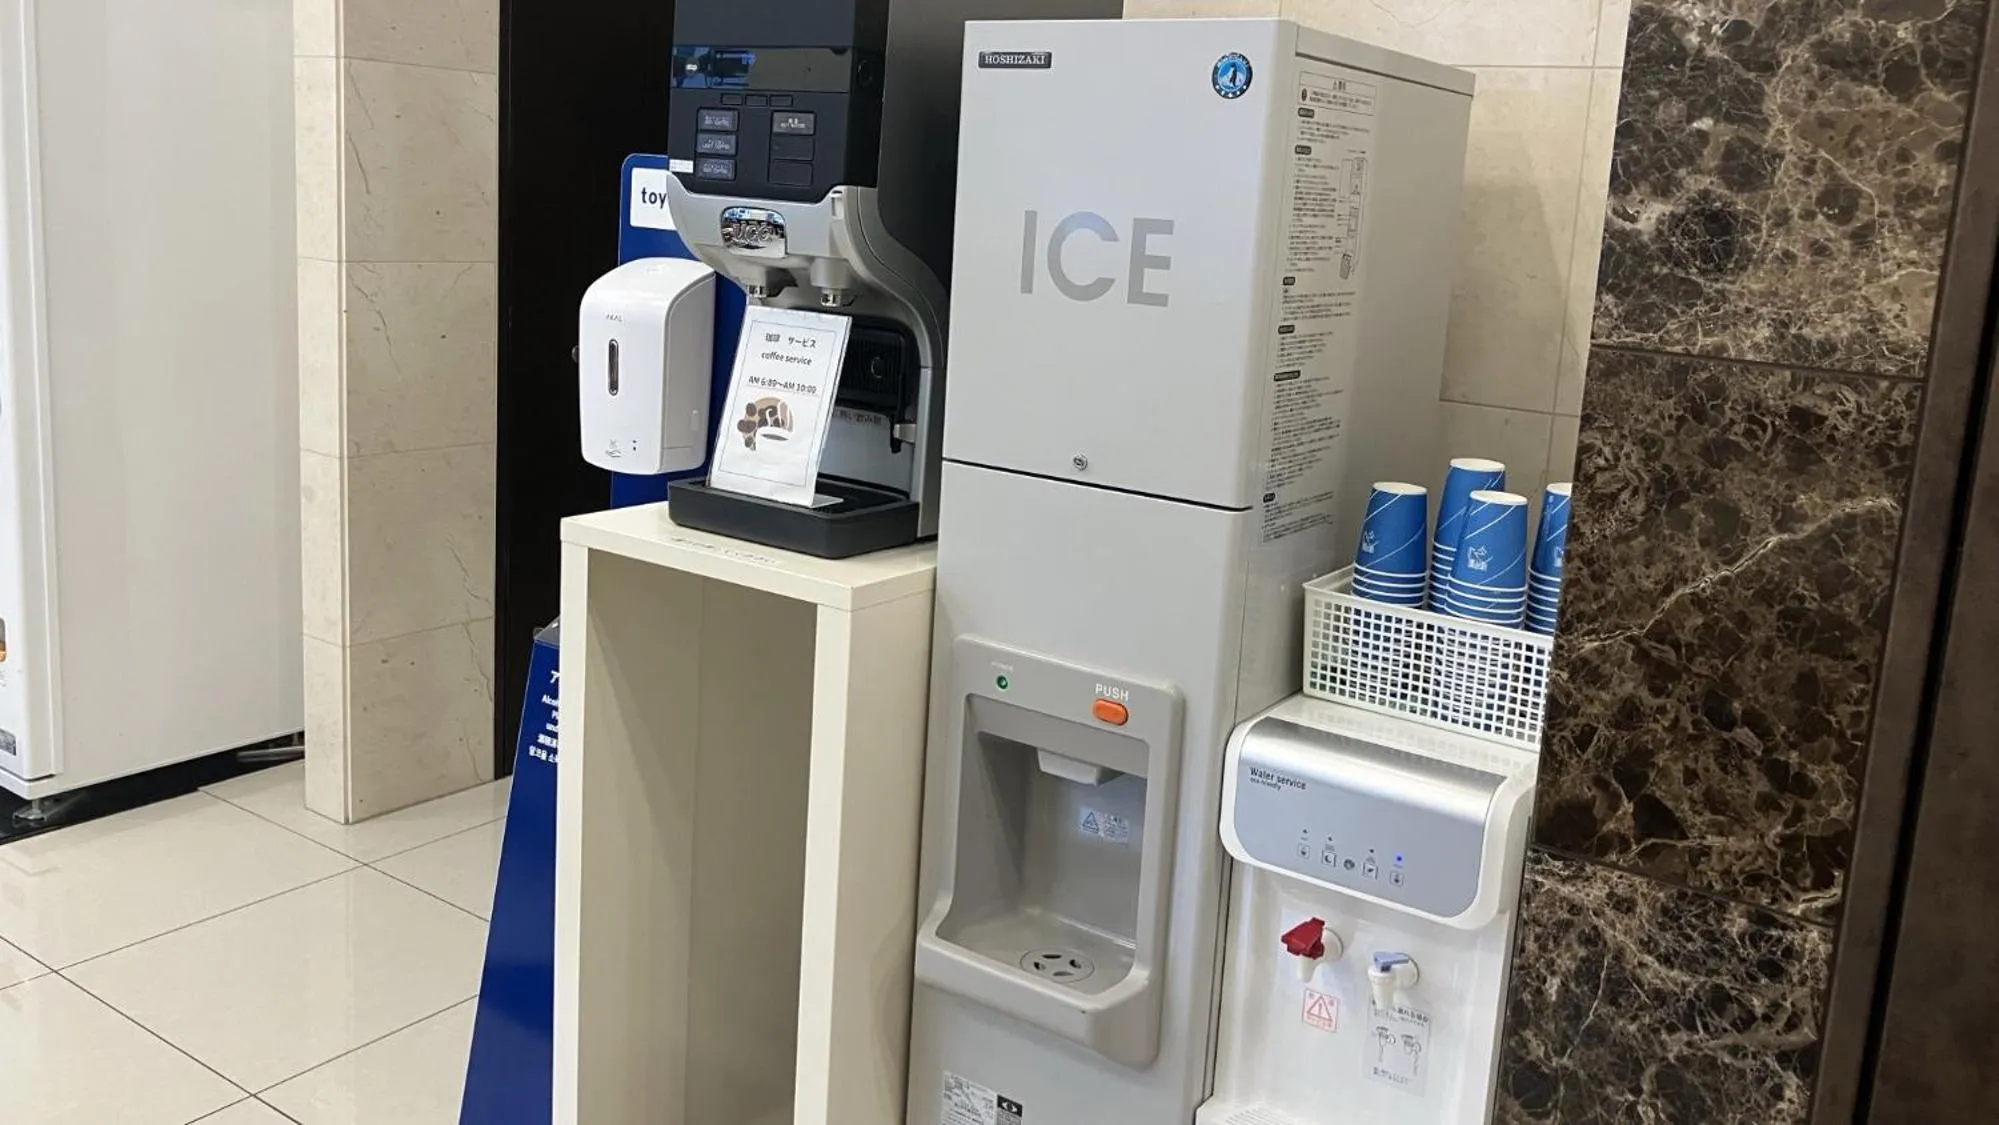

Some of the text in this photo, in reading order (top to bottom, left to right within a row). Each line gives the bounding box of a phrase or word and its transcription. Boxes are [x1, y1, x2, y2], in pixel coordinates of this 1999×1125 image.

[984, 54, 1046, 65] HOSHIZAKI
[641, 187, 667, 209] toy
[1020, 210, 1175, 308] ICE
[788, 336, 817, 349] サービス
[761, 350, 812, 366] coffee service
[748, 375, 760, 386] AM
[1095, 682, 1129, 701] PUSH
[1250, 767, 1306, 790] Water service
